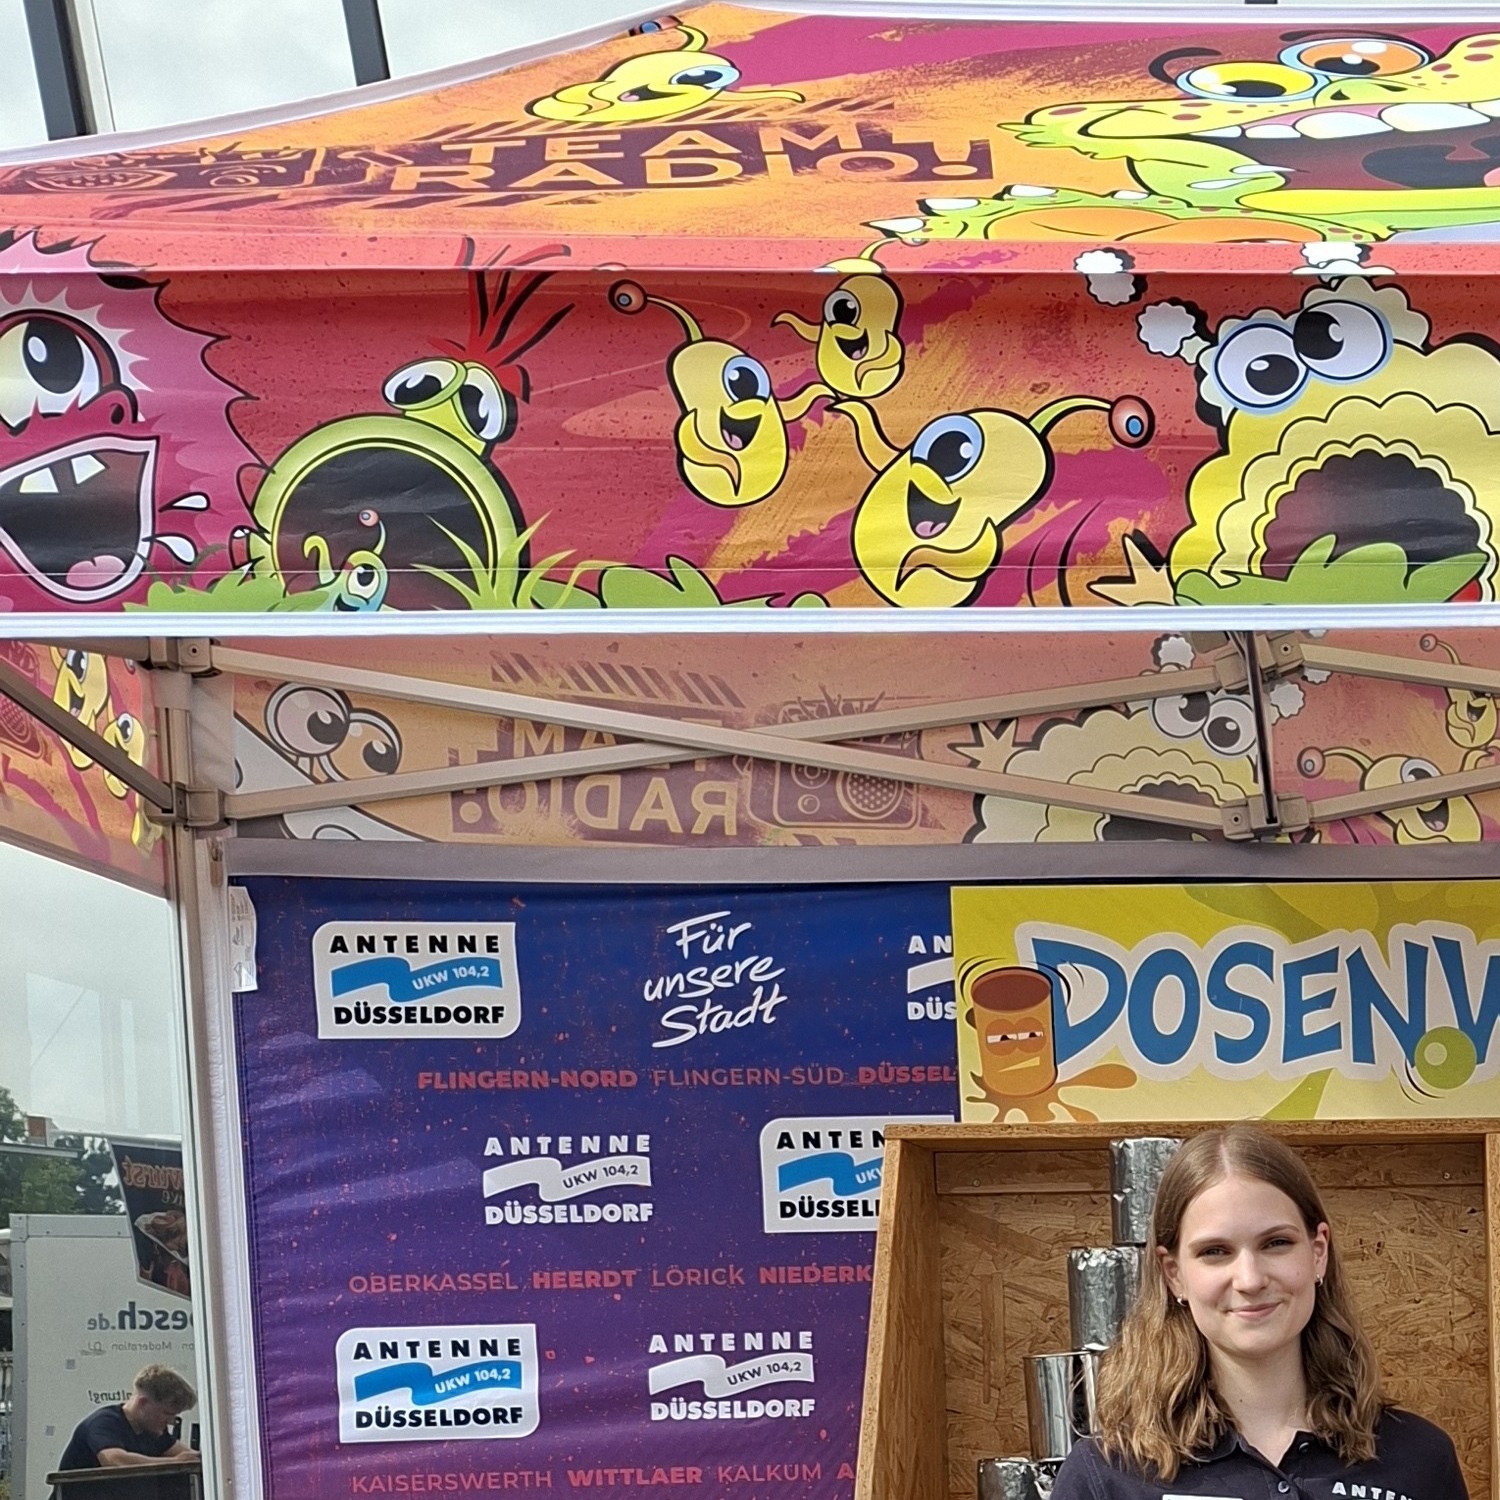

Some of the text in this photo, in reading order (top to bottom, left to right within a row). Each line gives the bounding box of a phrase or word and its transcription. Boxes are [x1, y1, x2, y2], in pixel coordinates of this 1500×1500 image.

[441, 122, 866, 165] TEAM
[390, 137, 979, 191] RADIO!
[329, 934, 500, 954] ANTENNE
[666, 910, 752, 960] Für
[411, 965, 490, 990] UKW 104,2
[643, 955, 786, 1002] unsere
[333, 1000, 505, 1025] DÜSSELDORF
[651, 982, 788, 1048] Stadt
[416, 1060, 957, 1090] FLINGERN-NORD FLINGERN-SÜD DÜSSEL
[483, 1134, 652, 1157] ANTENNE
[776, 1130, 886, 1150] ANTEN
[562, 1162, 640, 1190] UKW 104,2
[484, 1199, 654, 1226] DÜSSELDORF
[779, 1195, 881, 1219] DÜSSEL
[348, 1262, 873, 1293] OBERKASSEL HEERDT LÖRICK NIEDERK
[352, 1337, 522, 1361] ANTENNE
[648, 1330, 814, 1354] ANTENNE
[434, 1366, 512, 1395] UKW 104,2
[726, 1359, 803, 1387] UKW 104,2
[354, 1404, 524, 1430] DÜSSELDORF
[649, 1398, 816, 1421] DÜSSELDORF
[352, 1470, 553, 1493] KAISERSWERTH
[566, 1466, 703, 1487] WITTLAER
[718, 1462, 822, 1485] KALKUM
